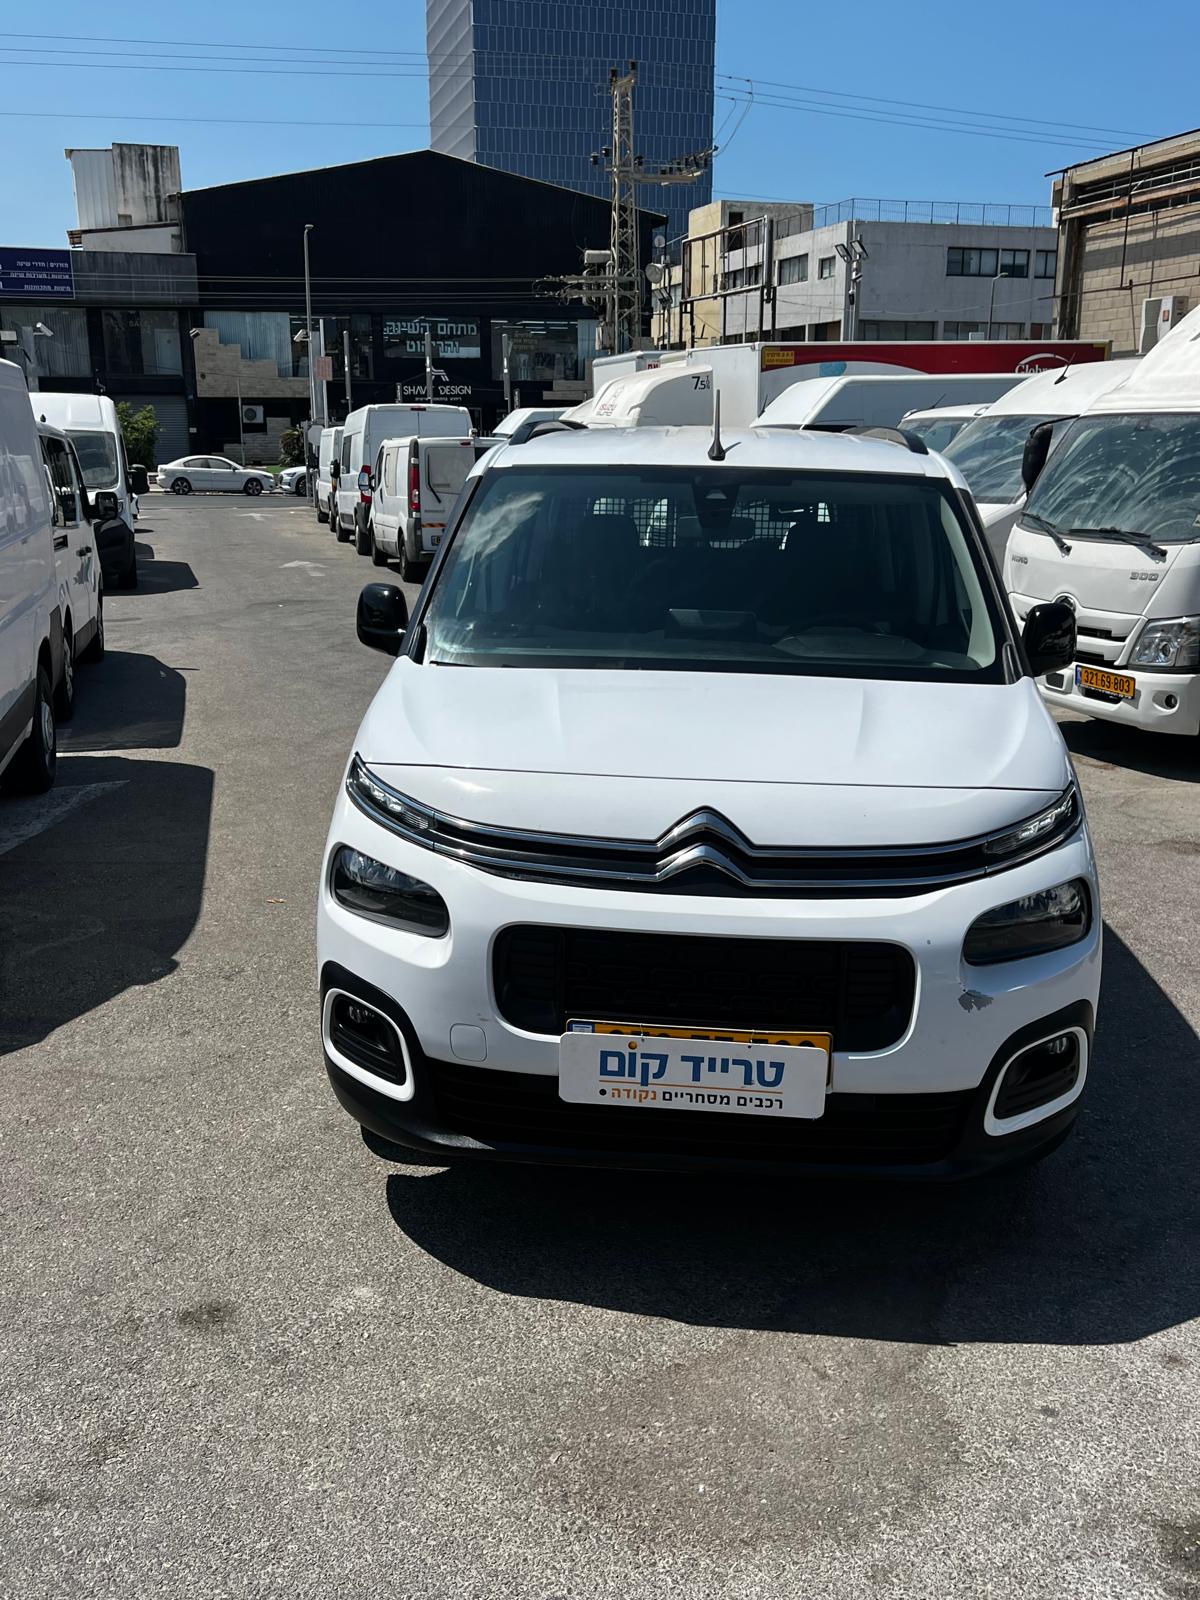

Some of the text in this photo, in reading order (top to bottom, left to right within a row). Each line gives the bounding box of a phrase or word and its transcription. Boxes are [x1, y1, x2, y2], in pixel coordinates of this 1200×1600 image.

[386, 321, 477, 336] מתחם השינה
[403, 385, 435, 395] SHAV
[438, 385, 472, 395] DESIGN
[691, 375, 706, 390] 7.5
[1129, 571, 1159, 581] 300
[599, 1041, 785, 1088] טרייד קום
[611, 1087, 783, 1109] רכבים מסחריים נקודה
